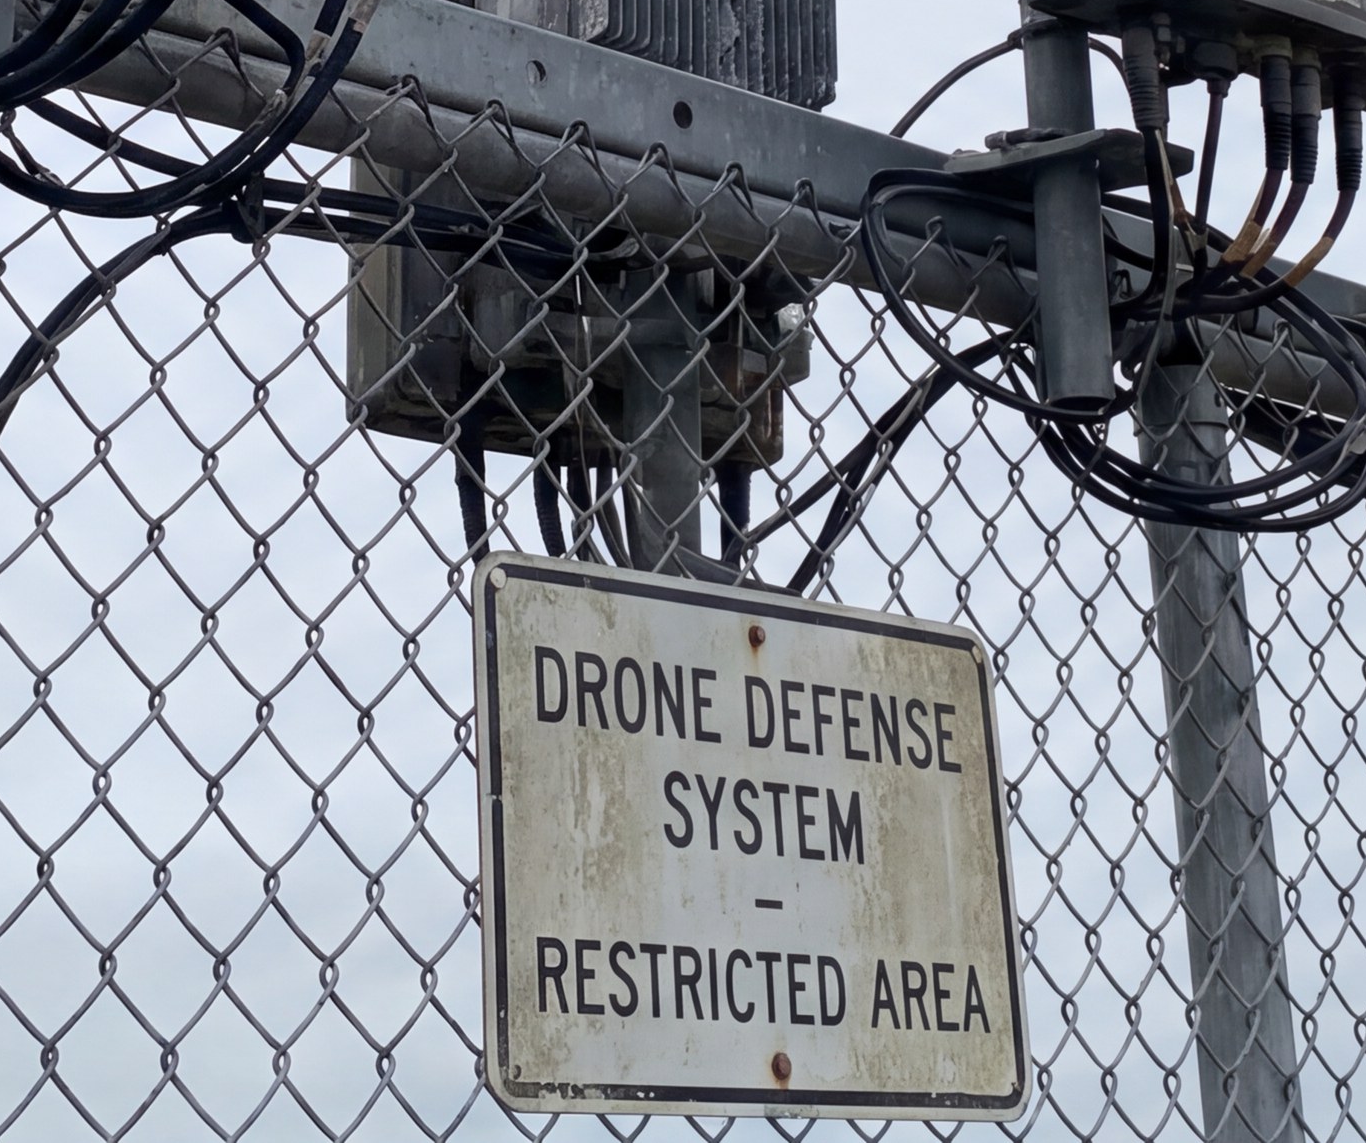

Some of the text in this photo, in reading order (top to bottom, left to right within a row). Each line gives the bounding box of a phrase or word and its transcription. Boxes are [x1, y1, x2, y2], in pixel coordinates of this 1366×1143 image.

[534, 645, 962, 774] DRONE DEFENSE
[663, 770, 865, 865] SYSTEM
[536, 936, 991, 1034] RESTRICTED AREA
